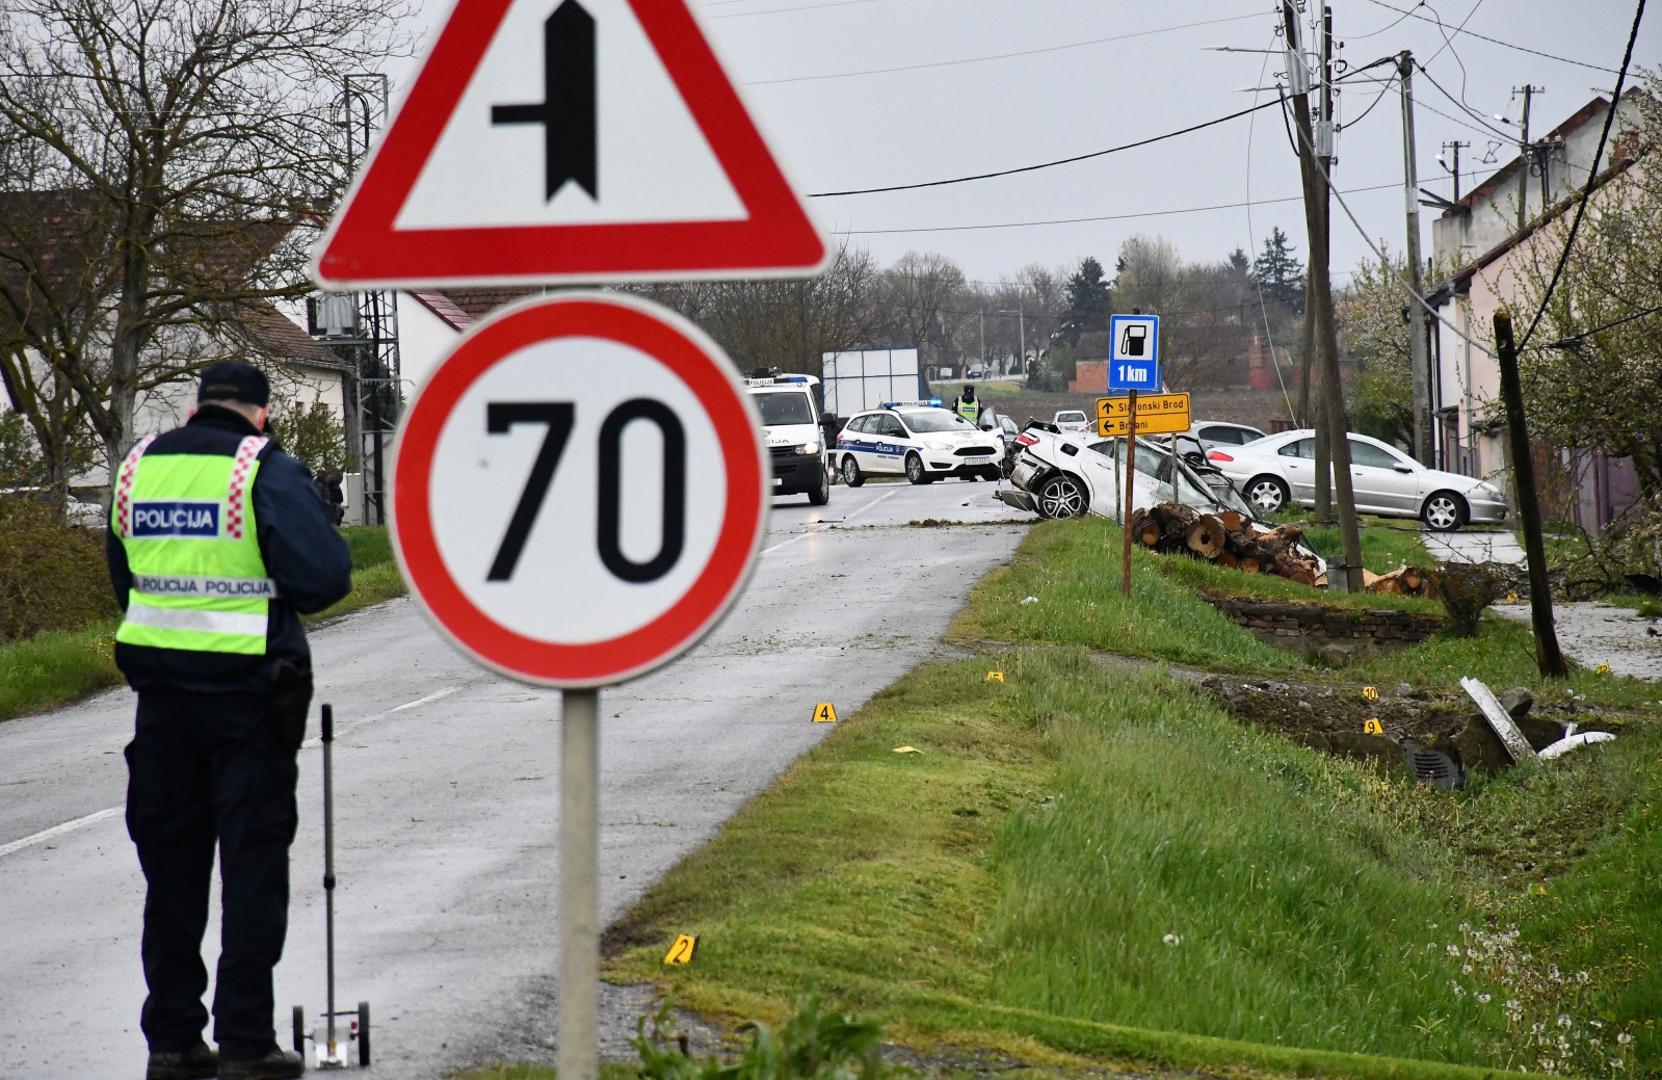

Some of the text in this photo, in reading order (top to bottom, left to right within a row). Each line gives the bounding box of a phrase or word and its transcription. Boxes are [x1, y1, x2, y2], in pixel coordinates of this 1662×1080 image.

[1118, 365, 1147, 382] 1 km
[1118, 399, 1184, 412] Slonski Brod
[1119, 421, 1148, 430] Brani
[486, 397, 686, 585] 70
[134, 510, 214, 529] POLICIJA
[143, 578, 198, 592] POLICIJA
[205, 580, 271, 594] POLICIJA
[1365, 688, 1376, 699] 10
[821, 705, 829, 720] 4
[1368, 721, 1375, 733] 9
[673, 939, 688, 964] 2
